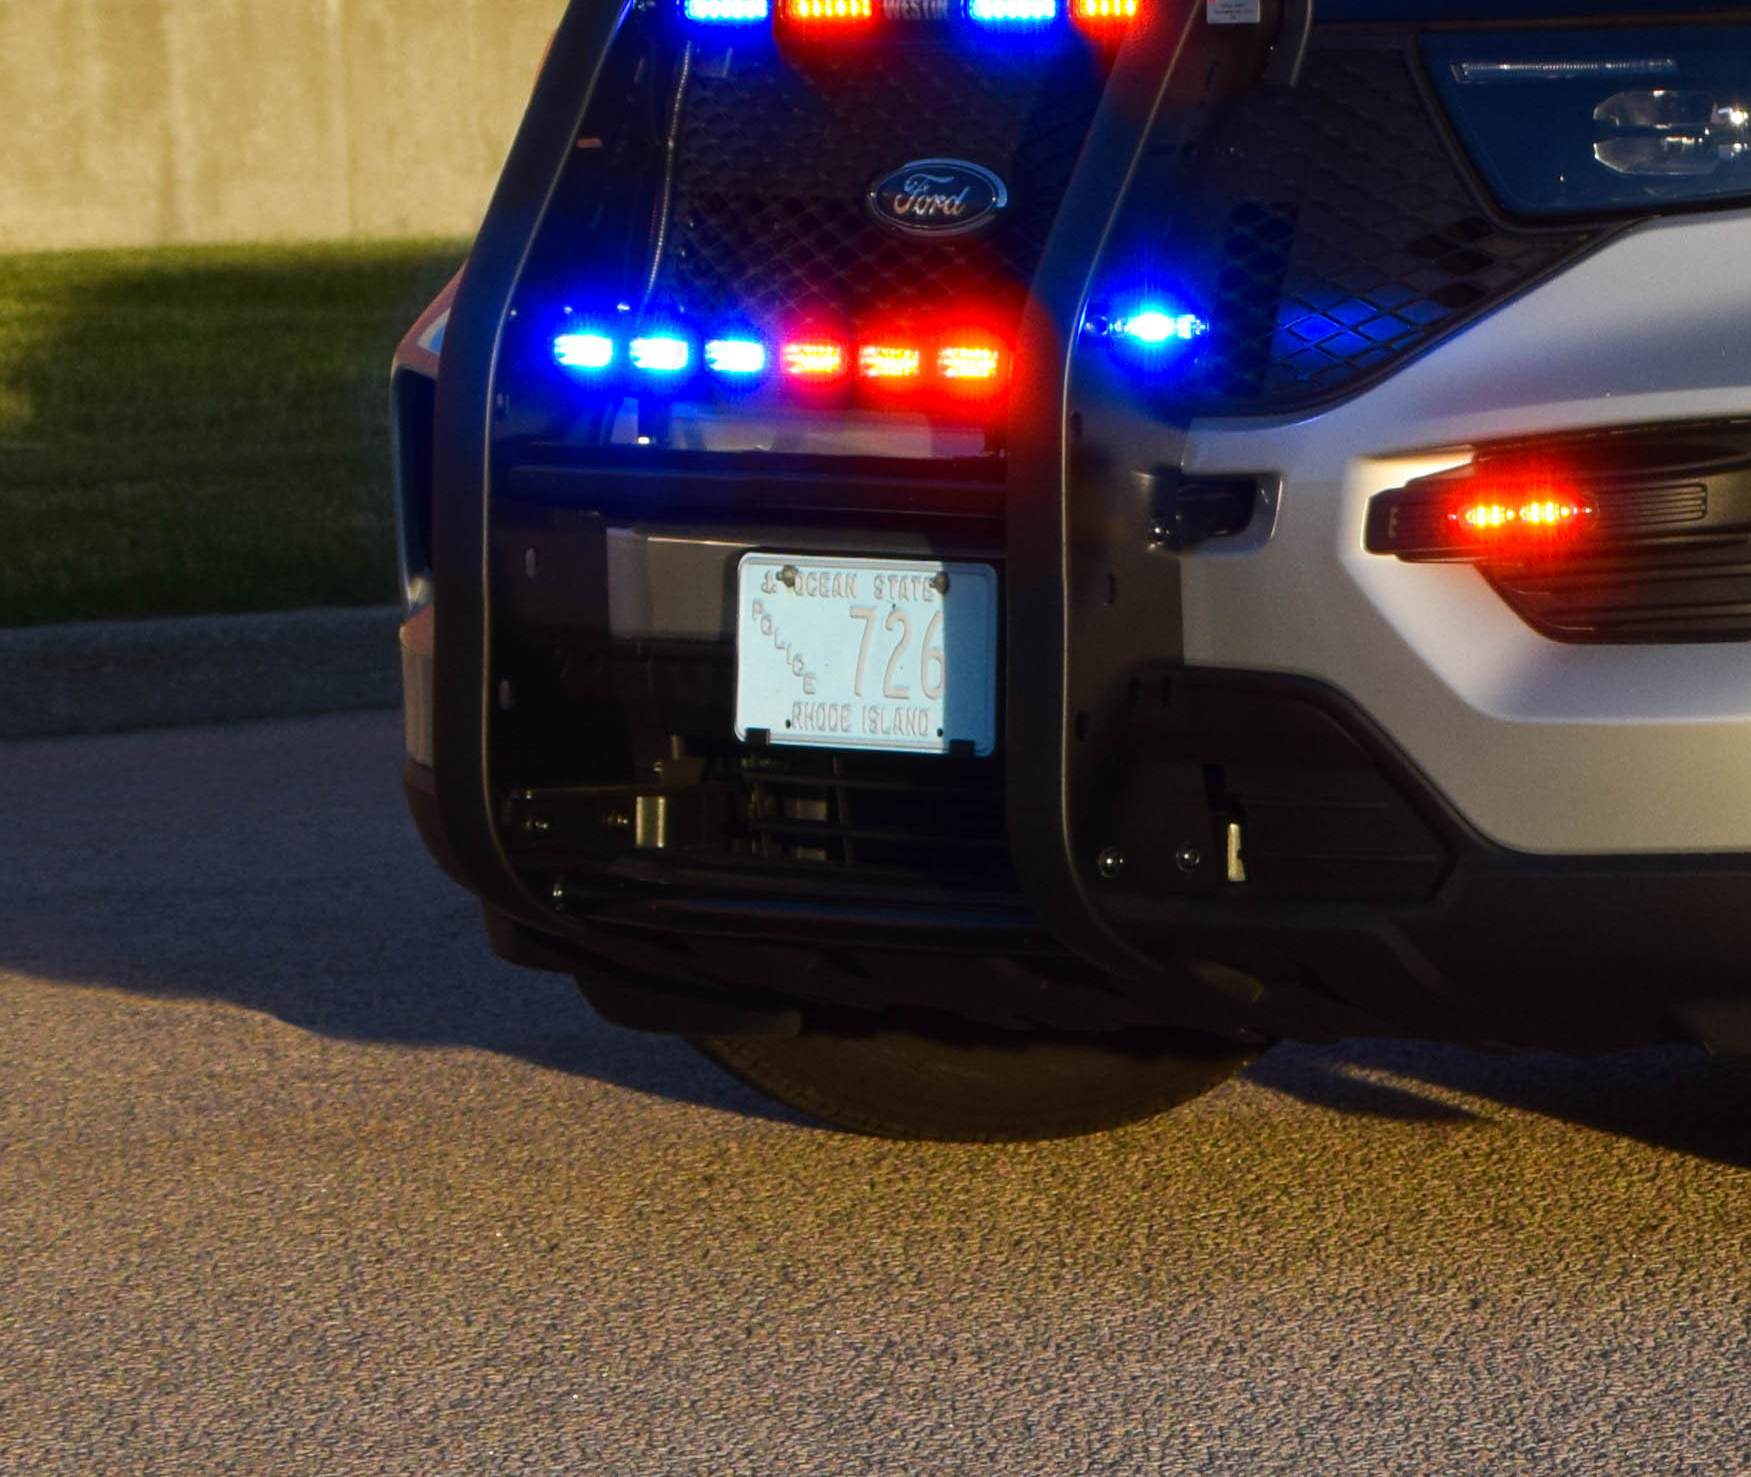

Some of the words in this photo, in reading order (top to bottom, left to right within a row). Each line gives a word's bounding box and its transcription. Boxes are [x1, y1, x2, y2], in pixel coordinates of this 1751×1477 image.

[894, 173, 970, 215] Ford
[794, 570, 857, 599] OCEAN
[873, 574, 935, 603] STATE
[752, 599, 817, 695] POLICE
[849, 605, 946, 700] 726
[791, 701, 853, 733] RHODE
[861, 704, 929, 738] ISLAND
